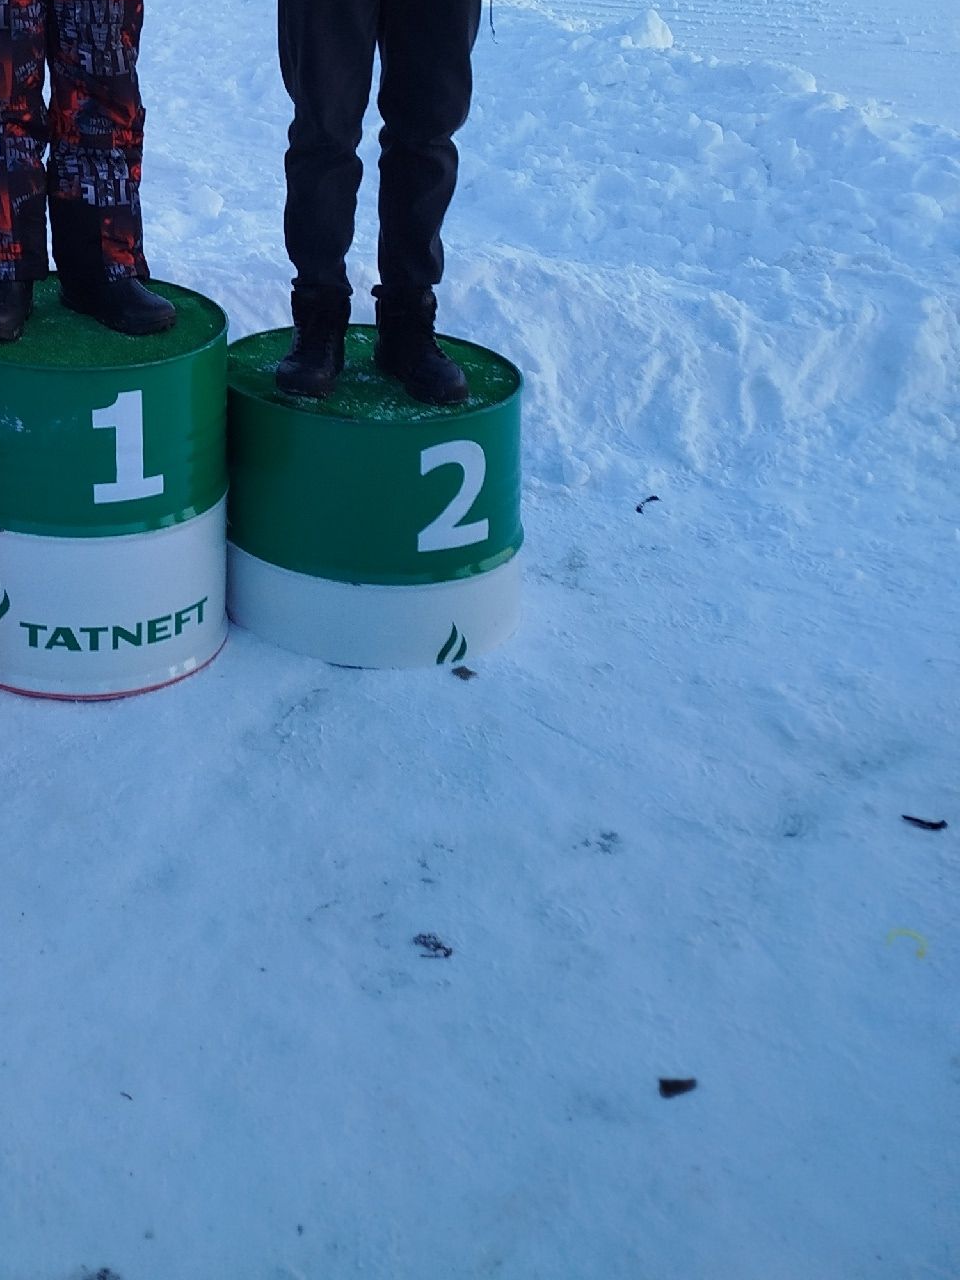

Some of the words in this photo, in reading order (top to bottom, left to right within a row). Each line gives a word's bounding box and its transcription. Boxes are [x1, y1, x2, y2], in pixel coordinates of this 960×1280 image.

[92, 389, 165, 505] 1
[416, 439, 490, 553] 2
[19, 596, 209, 652] TATNEFT
